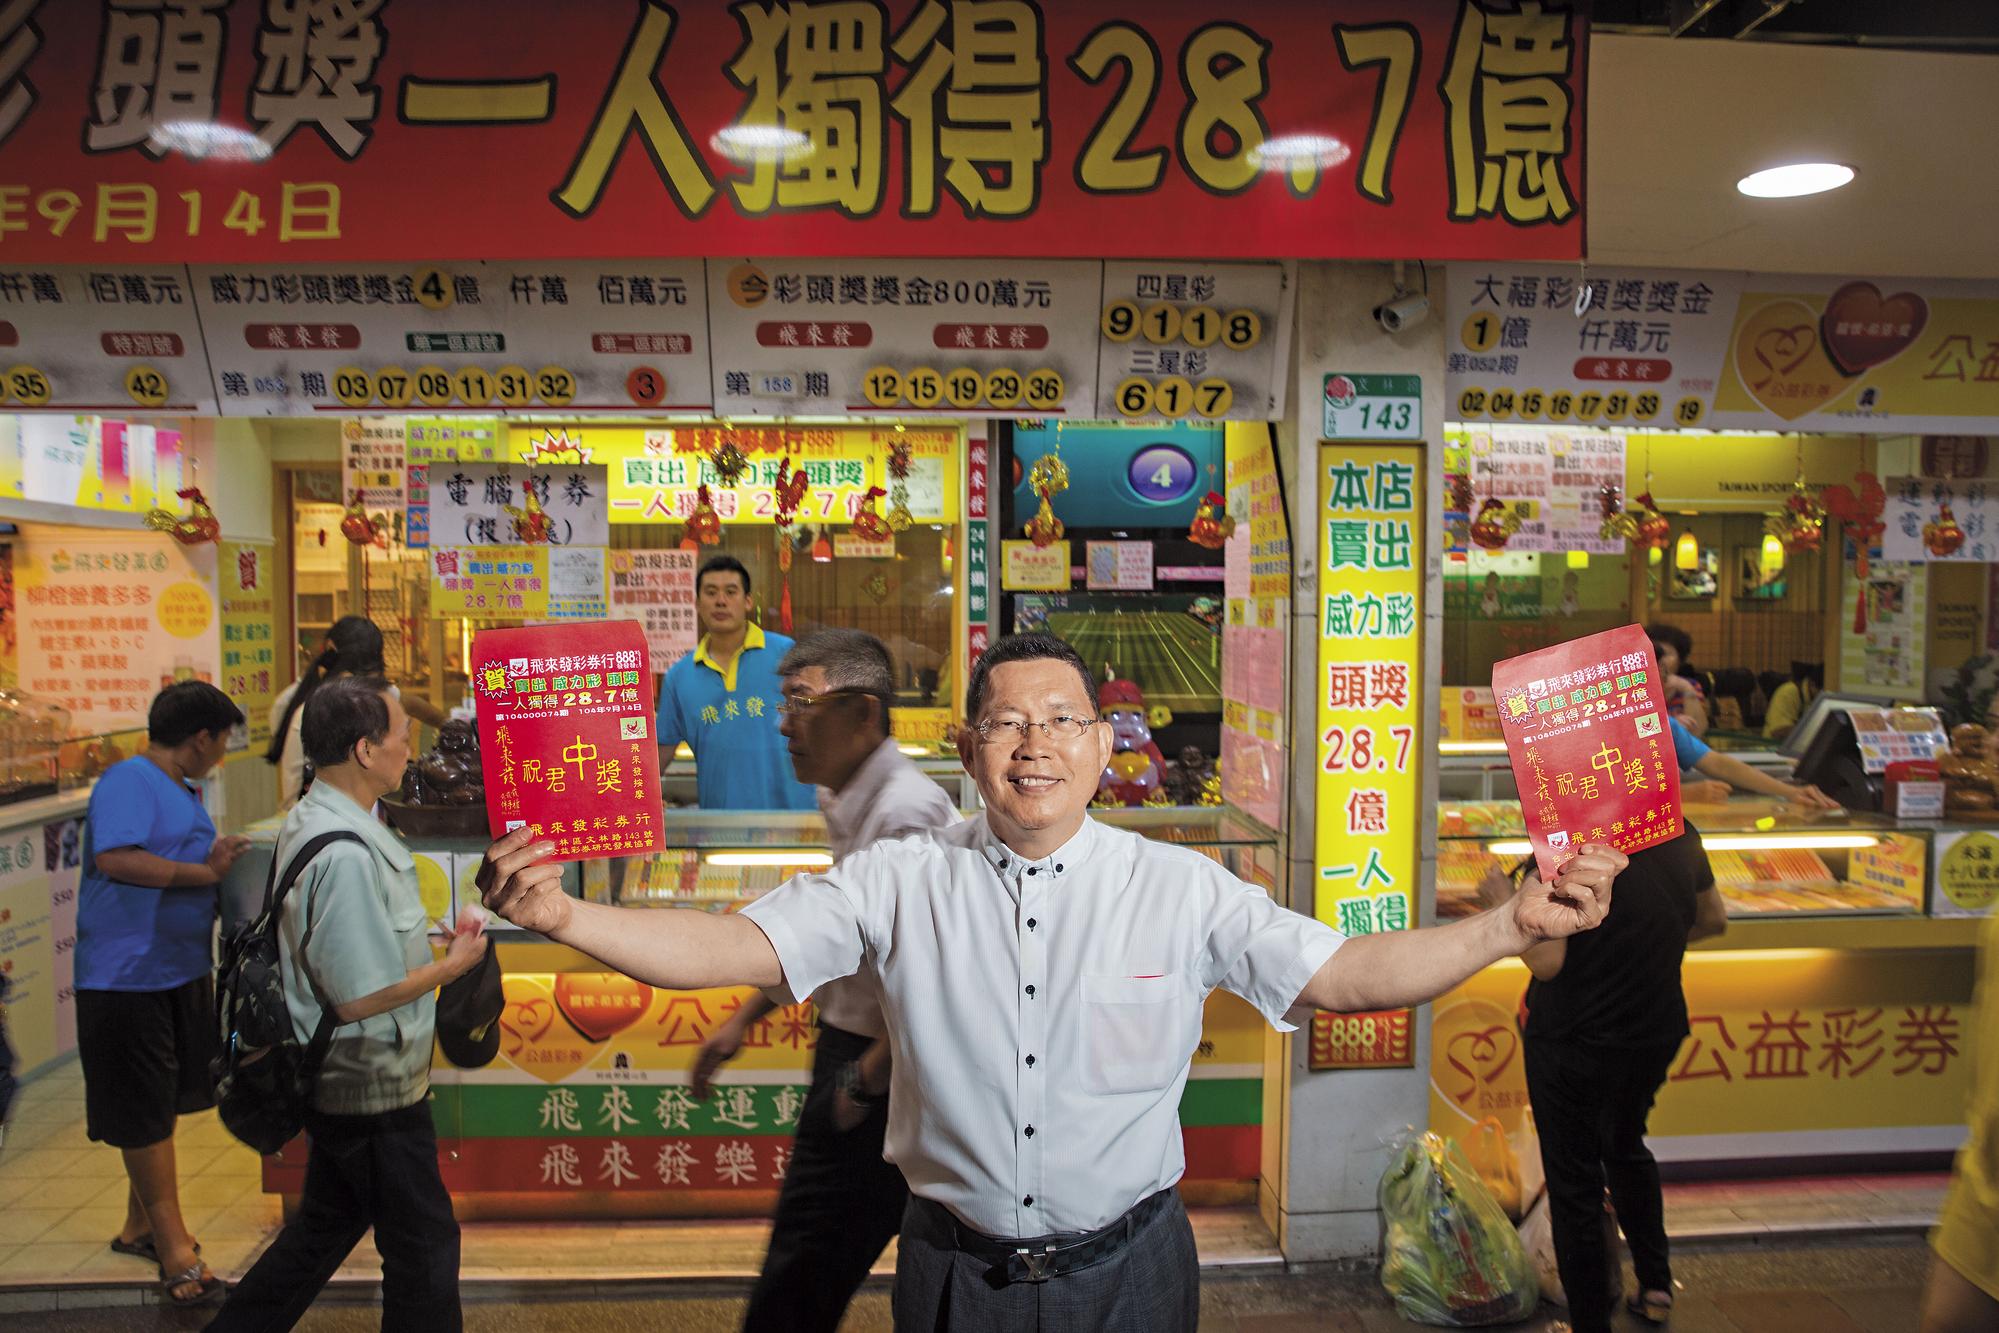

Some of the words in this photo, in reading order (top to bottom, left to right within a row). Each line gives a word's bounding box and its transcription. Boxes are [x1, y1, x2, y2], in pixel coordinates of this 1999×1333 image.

[89, 274, 183, 304] 佰萬元
[509, 275, 568, 305] 仟萬
[597, 275, 687, 305] 佰萬元
[740, 276, 1053, 307] 今彩頭獎獎金800萬元
[1136, 274, 1216, 300] 四星彩
[1109, 307, 1131, 334] 9
[1228, 314, 1252, 341] 8
[1579, 320, 1672, 353] 仟萬元
[1129, 351, 1207, 376] 三星彩
[11, 373, 46, 396] 35
[132, 372, 164, 397] 42
[336, 374, 369, 398] 03
[379, 377, 408, 401] 07
[418, 372, 449, 397] 08
[460, 374, 489, 399] 11
[501, 373, 529, 398] 31
[539, 374, 570, 398] 32
[637, 374, 656, 399] 3
[724, 371, 751, 397] 第
[803, 372, 829, 398] 期
[868, 374, 898, 398] 12
[908, 375, 937, 400] 15
[949, 375, 978, 400] 19
[988, 374, 1020, 399] 29
[1028, 374, 1059, 400] 36
[1121, 385, 1146, 411] 6
[1205, 387, 1226, 413] 7
[1359, 403, 1411, 431] 143
[1461, 393, 1485, 412] 02
[1491, 394, 1515, 413] 04
[1521, 392, 1541, 412] 15
[1550, 394, 1571, 414] 16
[1580, 393, 1600, 413] 17
[1608, 392, 1629, 413] 31
[1679, 400, 1700, 421] 19
[625, 460, 684, 484] 賣出
[803, 460, 863, 485] 頭獎
[1150, 463, 1172, 488] 4
[1329, 461, 1413, 510] 本店
[1762, 482, 1797, 492] SPORT
[1329, 521, 1411, 569] 賣出
[436, 551, 459, 577] 賀
[465, 594, 525, 609] 28.7億
[1326, 595, 1414, 636] 威力彩
[530, 653, 615, 674] 飛來發彩券行
[616, 650, 635, 663] 888
[1547, 658, 1622, 693] 飛來發彩券行
[1621, 652, 1641, 667] 888
[484, 669, 506, 690] 賀
[515, 678, 547, 693] 賣出
[552, 674, 601, 690] 威力彩
[606, 671, 640, 686] 頭獎
[1330, 664, 1408, 709] 頭獎
[1536, 694, 1568, 714] 賣出
[1570, 680, 1613, 705] 威力彩
[1616, 671, 1648, 690] 頭獎
[497, 692, 559, 711] 一人獨得
[562, 688, 639, 707] 28.7億
[579, 703, 642, 715] 104年9月14日
[702, 696, 765, 725] 飛來發
[1507, 693, 1530, 717] 賀
[1523, 707, 1580, 731] 一人獨得
[1582, 687, 1649, 717] 28.7億
[1324, 728, 1413, 770] 28.7
[522, 735, 622, 795] 祝君中獎
[630, 743, 645, 800] 飛來發按摩
[1556, 742, 1649, 800] 祝君中獎
[530, 812, 651, 837] 飛來發彩券行
[1347, 791, 1386, 832] 億
[1571, 802, 1672, 845] 飛來發彩券行
[553, 830, 654, 847] 林區文林路143號
[1323, 851, 1392, 887] 一人
[1339, 896, 1408, 938] 獨得
[1331, 1017, 1377, 1047] 888
[1671, 1005, 1960, 1083] 公益彩券
[539, 1086, 806, 1131] 飛來發運動
